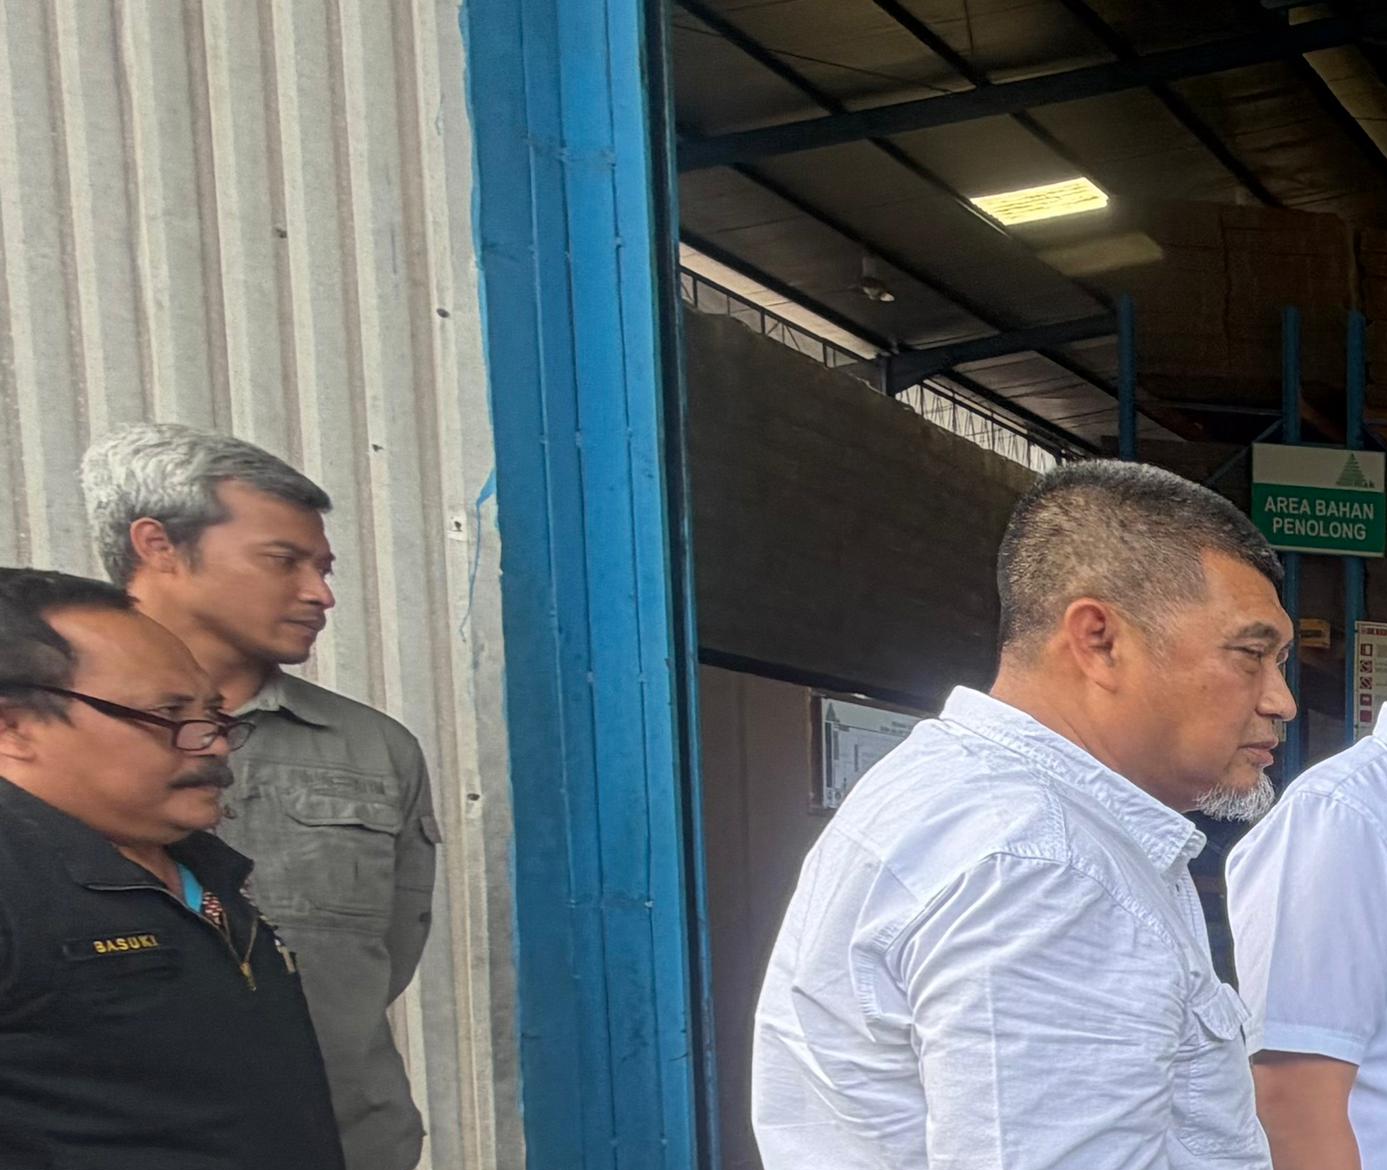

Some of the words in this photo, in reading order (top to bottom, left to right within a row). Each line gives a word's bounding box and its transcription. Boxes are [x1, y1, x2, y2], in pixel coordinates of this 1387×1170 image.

[1264, 496, 1311, 515] AREA
[1315, 499, 1374, 520] BAHAN
[1272, 517, 1366, 540] PENOLONG
[93, 934, 158, 954] BASUKI
